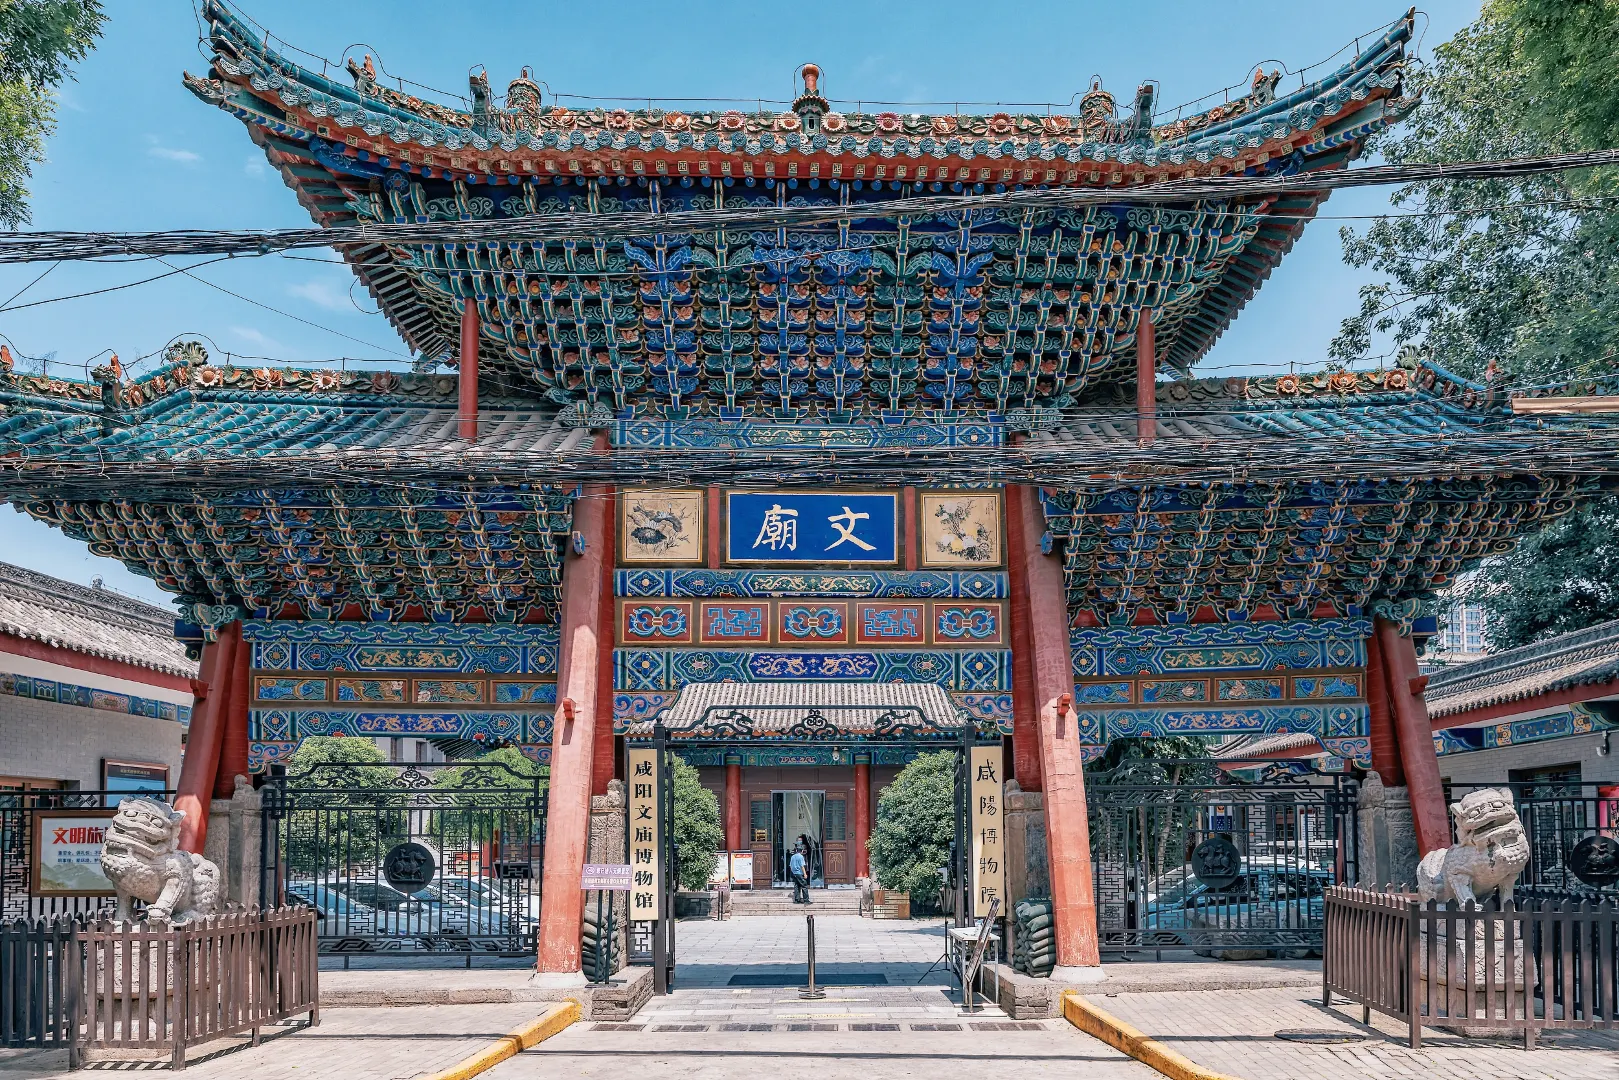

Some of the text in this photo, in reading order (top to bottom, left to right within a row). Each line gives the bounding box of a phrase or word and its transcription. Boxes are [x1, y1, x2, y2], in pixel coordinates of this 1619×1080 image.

[52, 826, 108, 845] 文明旅
[634, 760, 654, 909] 咸阳文庙博物馆
[976, 758, 998, 905] 咸陽博物院
